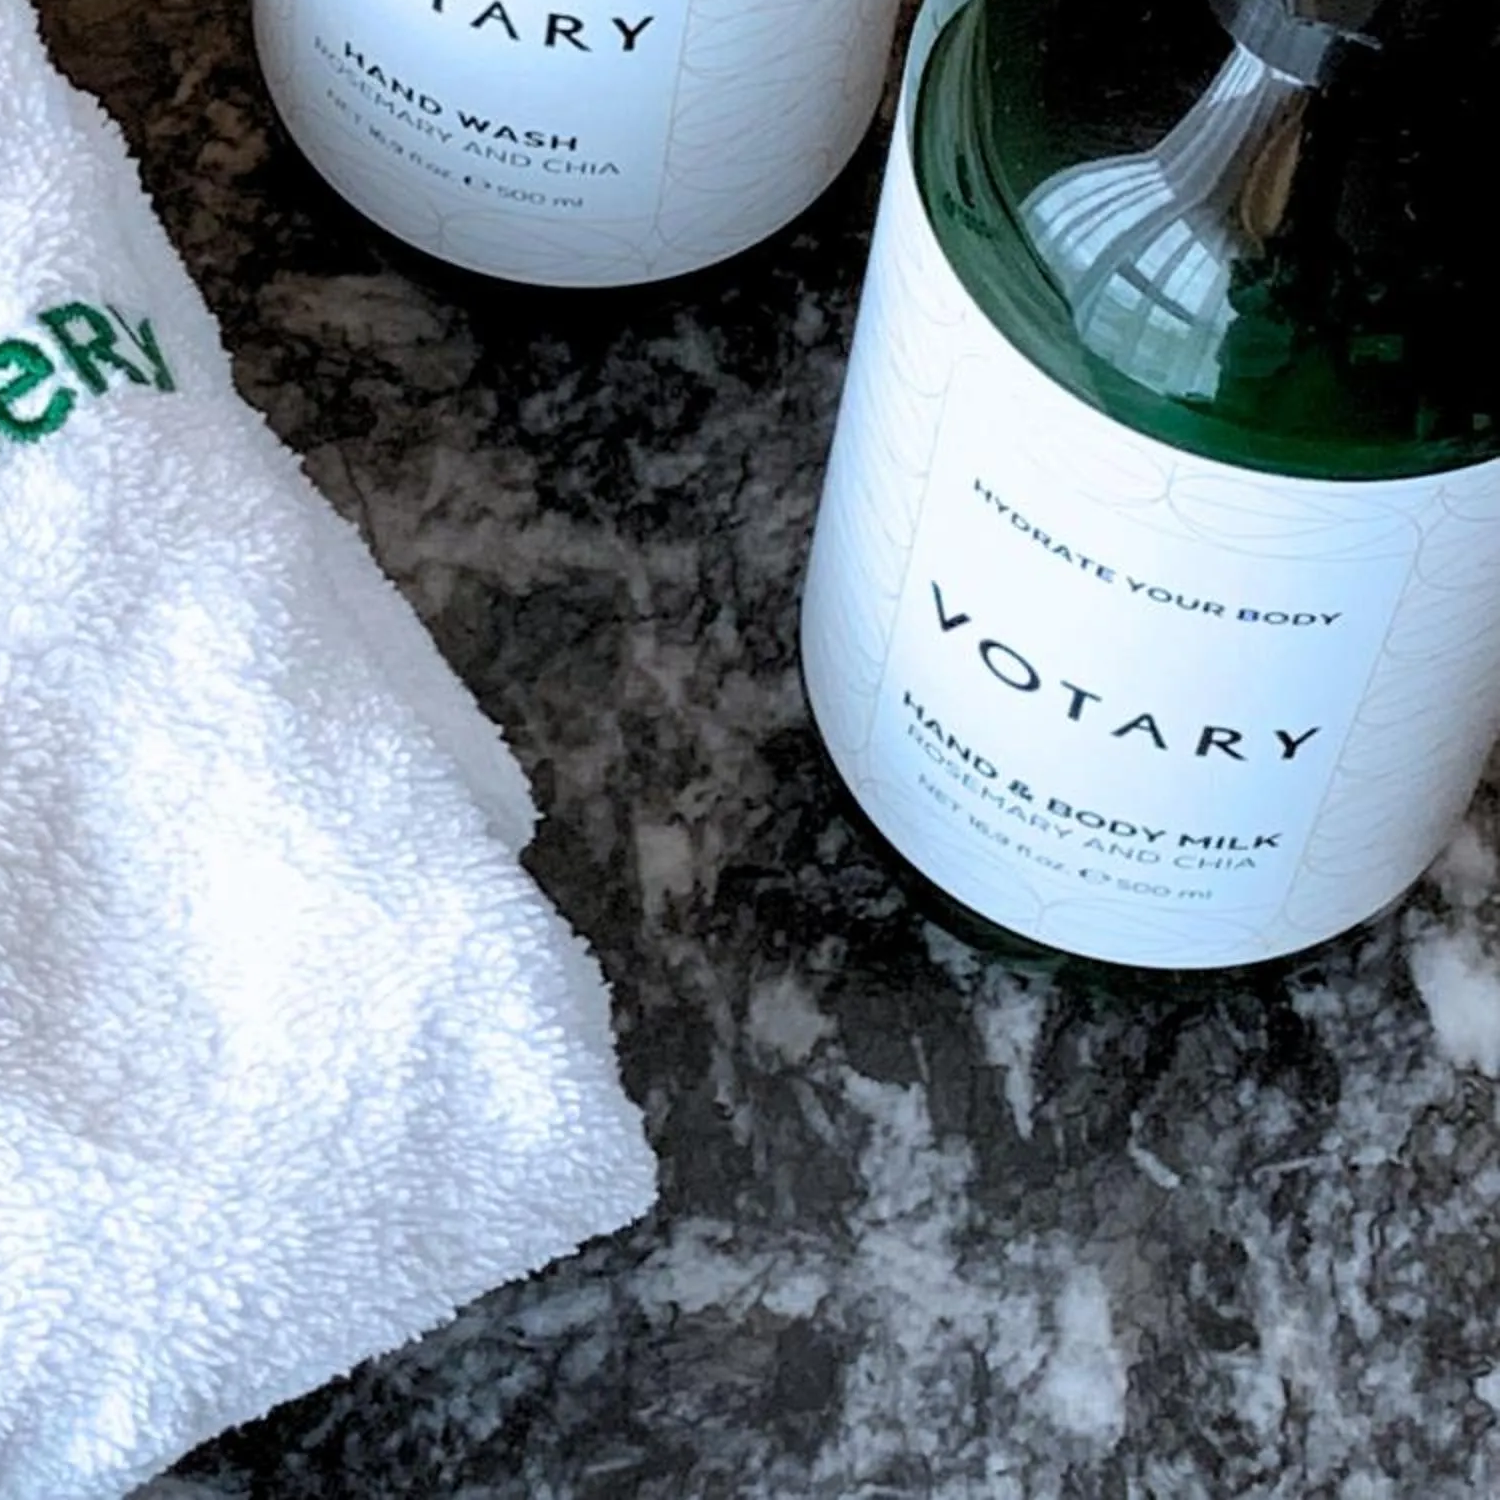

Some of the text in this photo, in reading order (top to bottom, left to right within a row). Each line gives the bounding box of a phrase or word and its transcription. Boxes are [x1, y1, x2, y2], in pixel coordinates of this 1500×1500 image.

[345, 41, 577, 151] HAND WASH
[463, 141, 532, 167] AND
[542, 159, 620, 175] CHIA
[975, 478, 1343, 626] HYDRATE YOUR BODY
[931, 580, 1322, 763] VOTARY
[903, 691, 1283, 851] HAND & BODY MILK
[908, 724, 1256, 870] ROSEMARY AND CHIA
